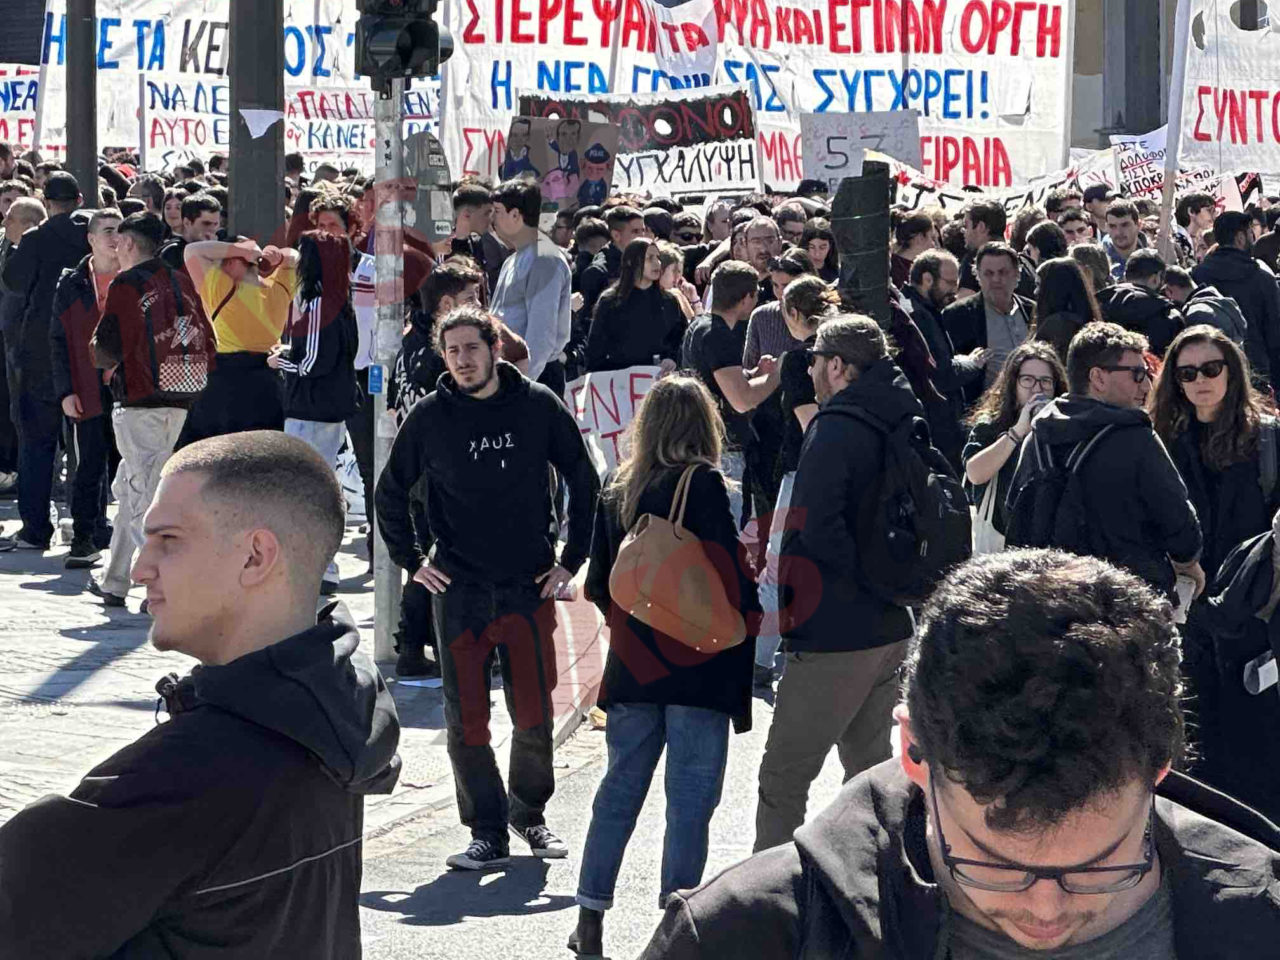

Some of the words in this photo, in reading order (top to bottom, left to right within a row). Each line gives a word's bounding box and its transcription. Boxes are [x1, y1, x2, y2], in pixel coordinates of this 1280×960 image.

[776, 6, 824, 45] ΚΑΙ
[132, 19, 166, 71] ΤΑ
[179, 18, 230, 75] ΚΕ
[147, 80, 186, 111] ΝΑ
[491, 60, 512, 110] Η
[150, 118, 206, 148] ΑΥΤΟ
